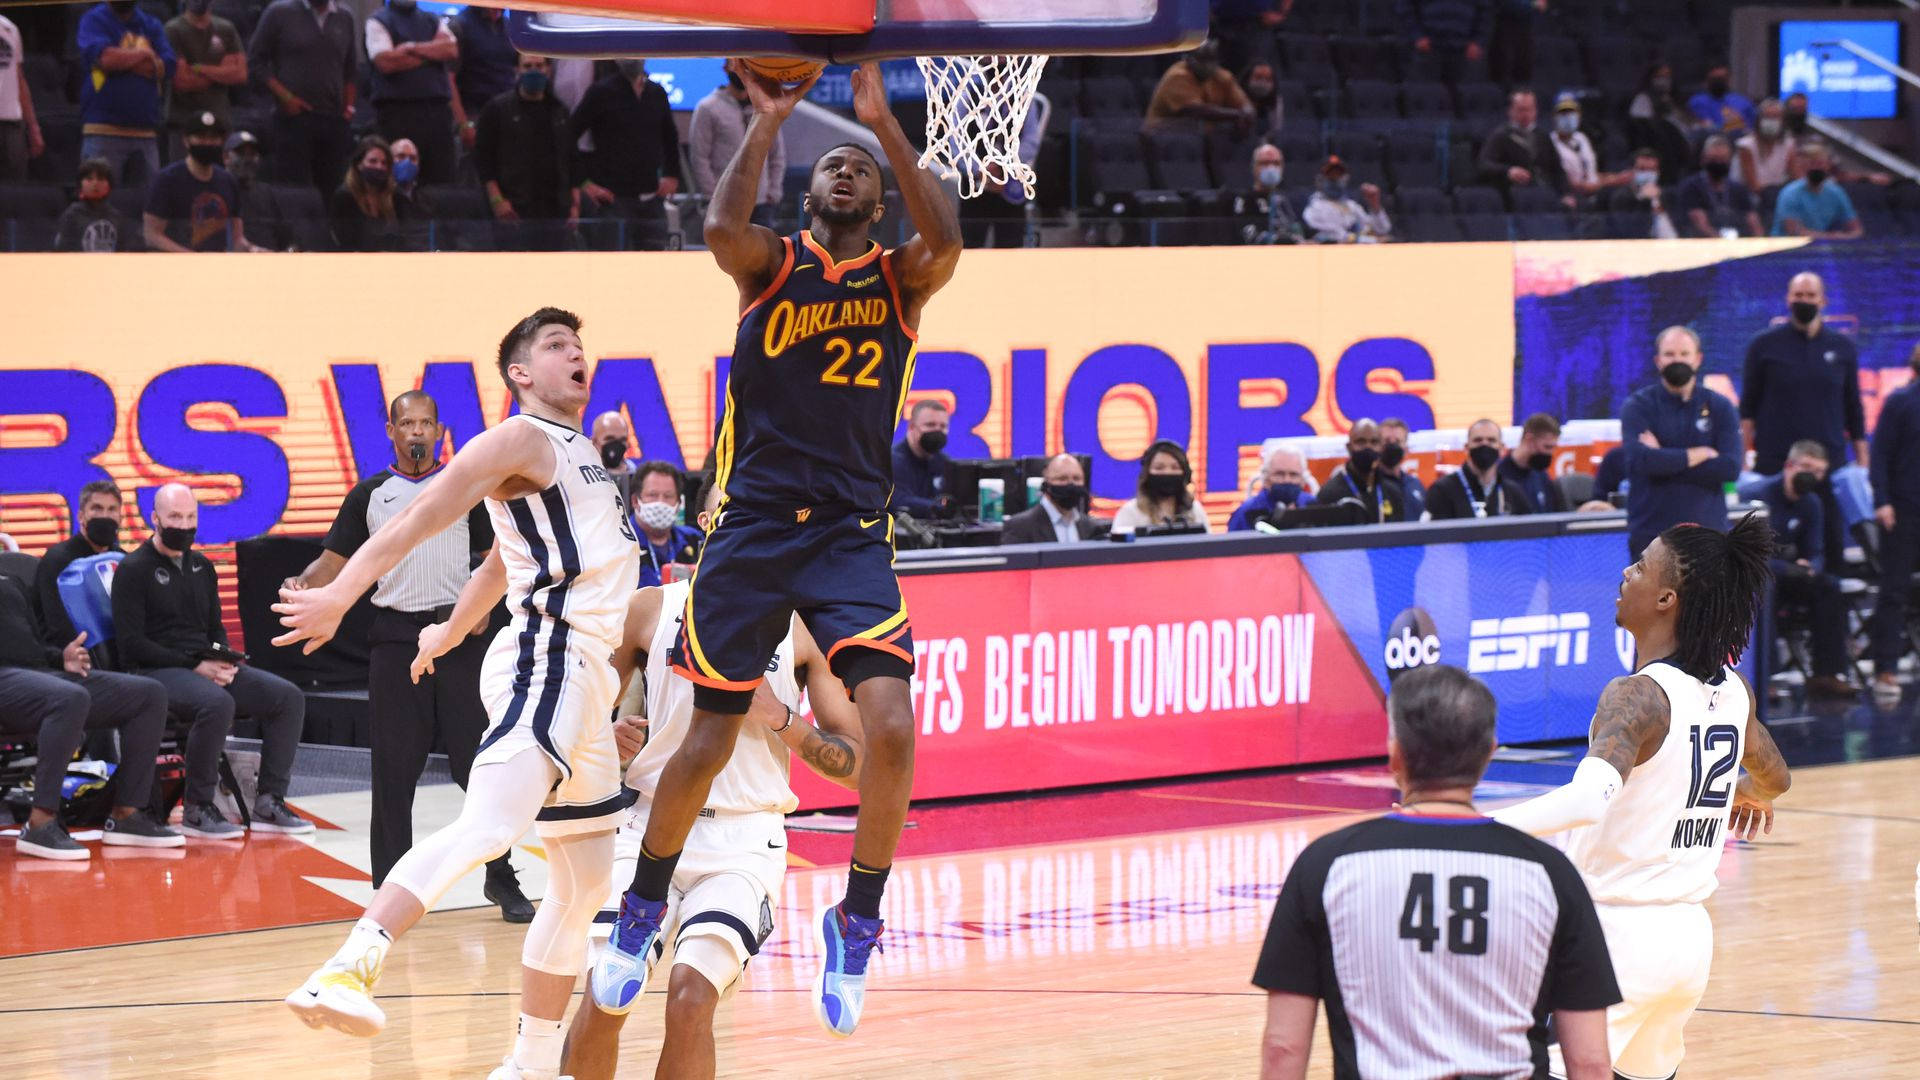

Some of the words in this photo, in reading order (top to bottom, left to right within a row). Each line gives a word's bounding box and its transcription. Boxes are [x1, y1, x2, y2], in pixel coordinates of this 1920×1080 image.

[846, 274, 880, 289] Rakuten
[764, 299, 888, 358] OAKLAND
[820, 336, 883, 388] 22
[330, 337, 1437, 502] WARIORS
[984, 629, 1098, 730] BEGIN
[1107, 613, 1316, 720] TOMORROW
[1384, 626, 1441, 670] abc
[1467, 611, 1591, 674] ESPN
[1685, 724, 1739, 809] 12
[1398, 872, 1489, 956] 48
